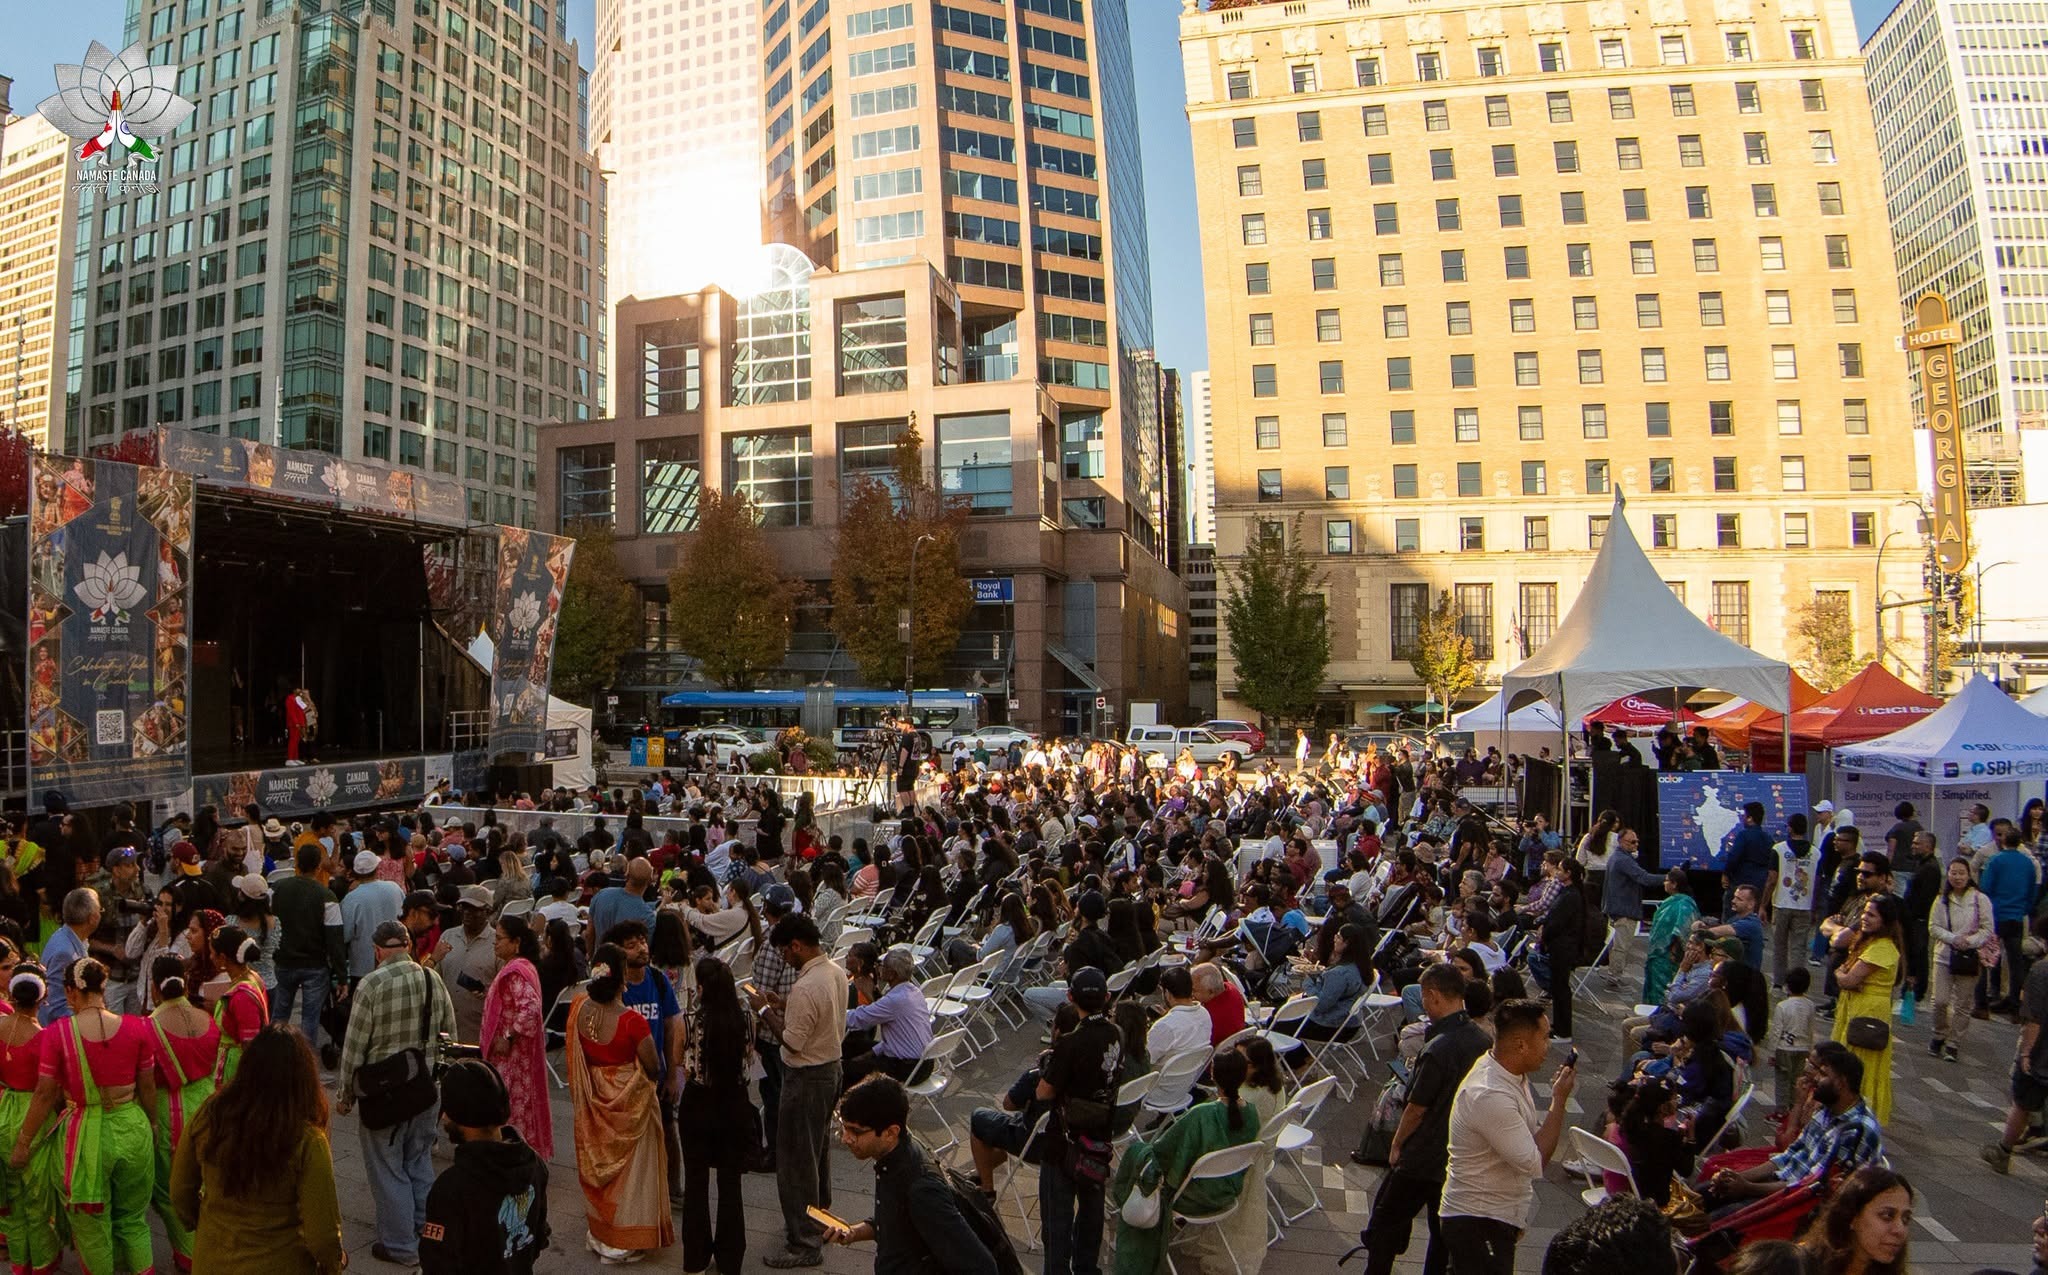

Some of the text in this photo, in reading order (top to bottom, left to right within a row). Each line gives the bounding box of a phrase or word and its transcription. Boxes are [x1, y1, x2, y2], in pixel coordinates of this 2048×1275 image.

[1909, 328, 1960, 346] HOTEL
[1926, 353, 1961, 544] GEORGIA
[286, 460, 314, 474] NAMASTE
[356, 473, 377, 486] CANADA
[976, 582, 1001, 591] Royal
[976, 591, 999, 599] Bank
[90, 626, 129, 634] NAMASTE CANADA
[1869, 706, 1938, 715] ICICI Ban
[1974, 743, 2002, 752] SBI
[1986, 760, 2012, 776] SBI
[346, 771, 370, 784] CANADA
[268, 778, 299, 792] NAMASTE
[1844, 791, 1883, 803] Banking
[1942, 789, 1992, 801] Simplified.
[424, 1223, 443, 1239] EFF
